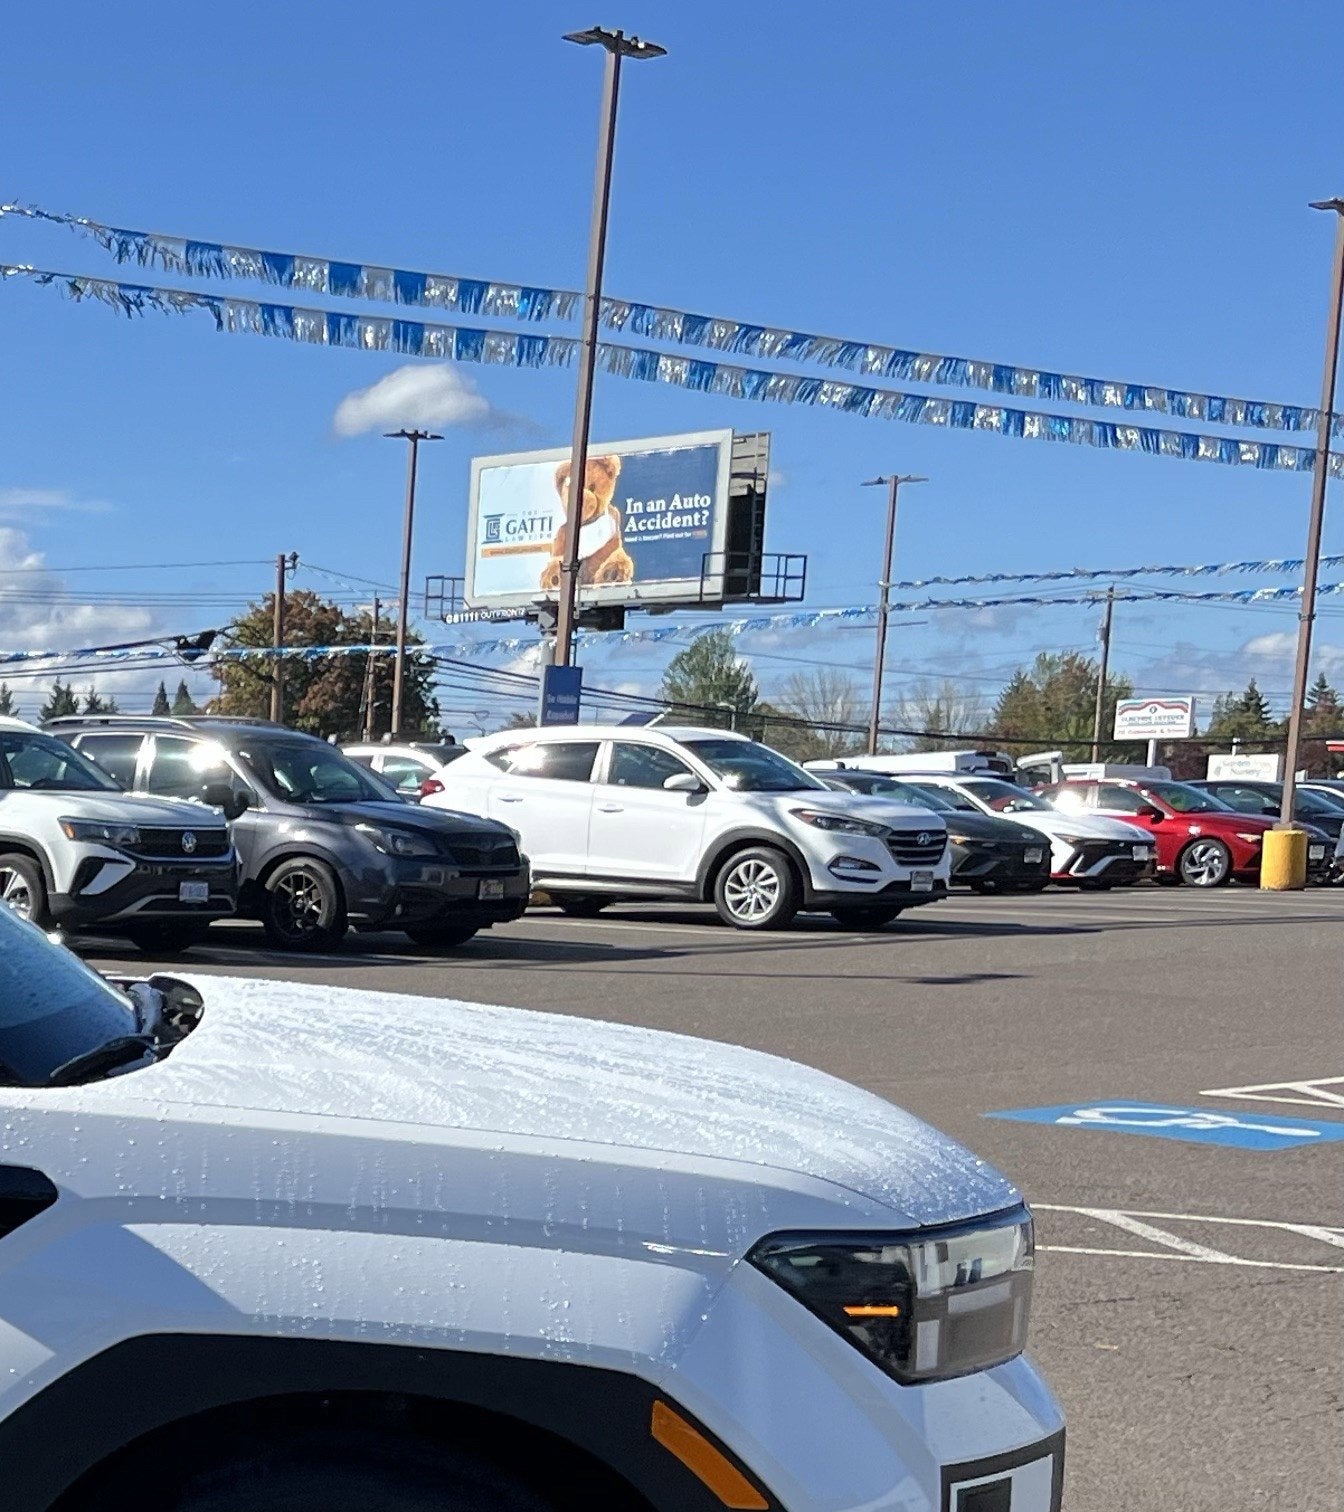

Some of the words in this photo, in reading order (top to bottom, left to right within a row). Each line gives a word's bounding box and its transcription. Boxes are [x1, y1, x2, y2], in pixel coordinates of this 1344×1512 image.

[625, 498, 643, 514] In
[646, 499, 666, 513] an
[668, 493, 711, 510] Auto
[505, 516, 553, 535] GATTI
[624, 509, 710, 532] Accident?
